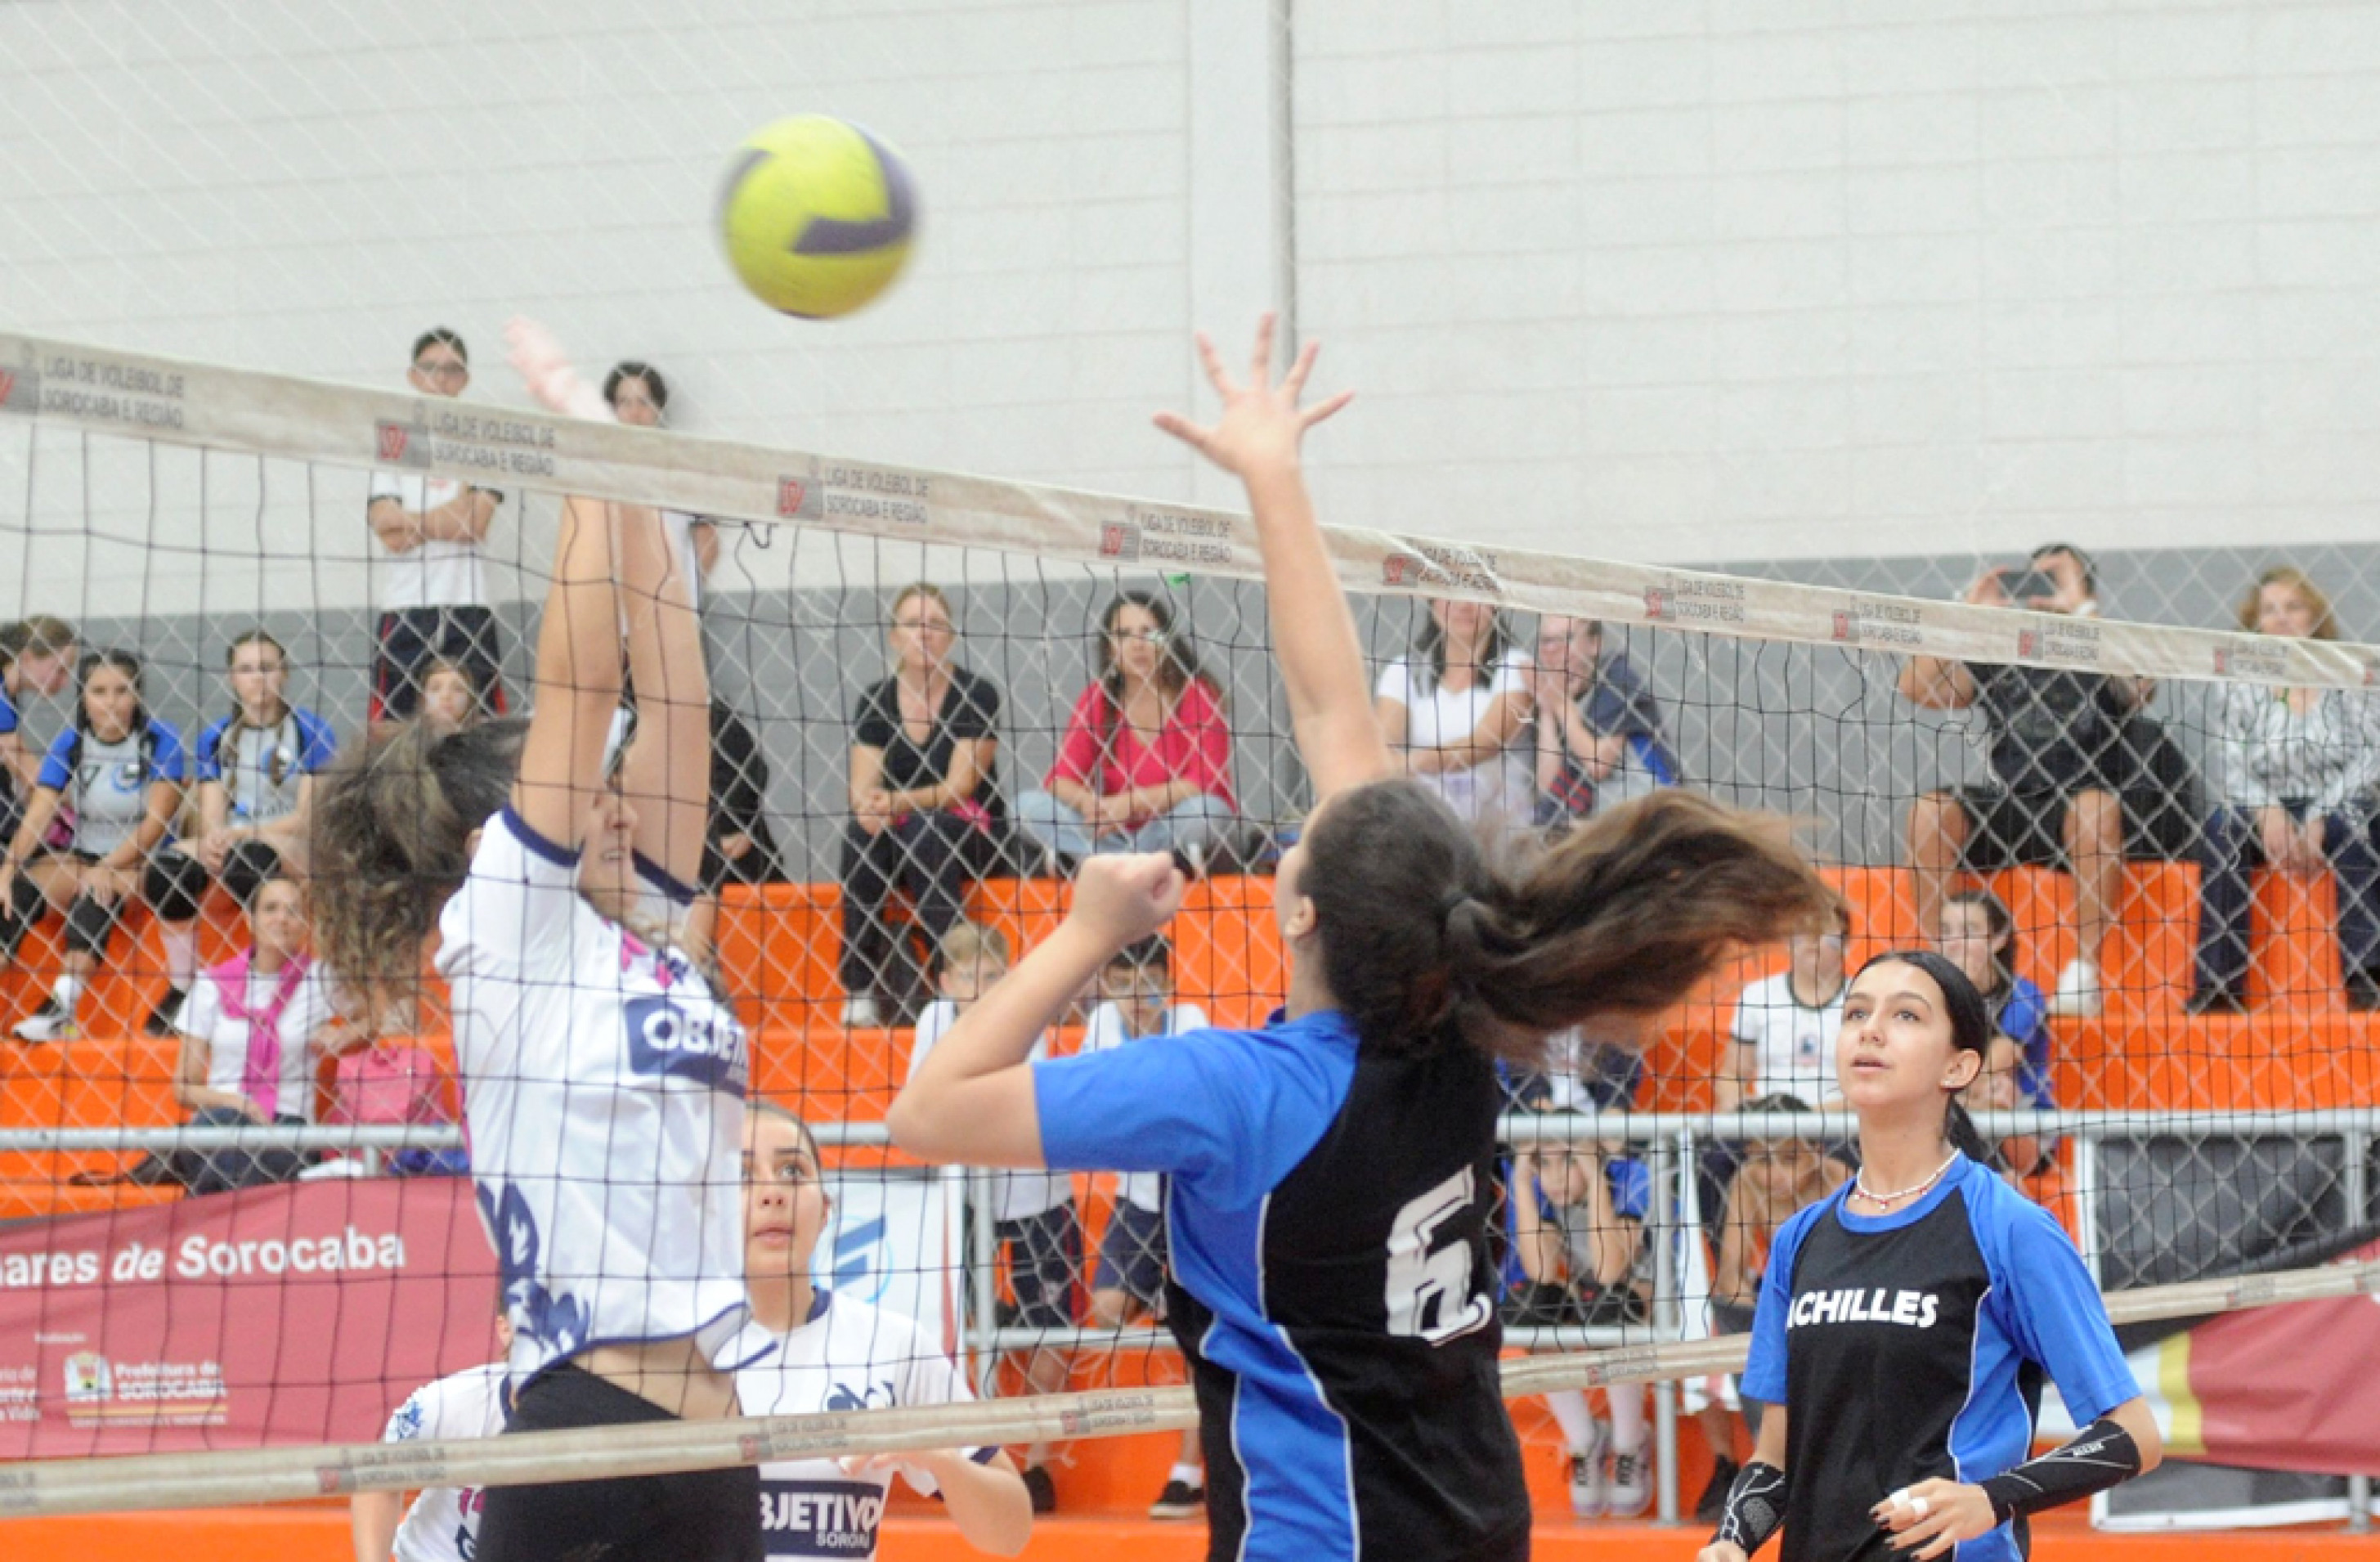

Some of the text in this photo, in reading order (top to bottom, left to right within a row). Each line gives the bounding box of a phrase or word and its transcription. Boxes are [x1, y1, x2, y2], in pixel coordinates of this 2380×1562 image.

[43, 355, 184, 398] LIGA DE VOLEIBOL DE
[43, 388, 119, 418] SOROCABA
[122, 397, 132, 421] E
[432, 411, 554, 449] LIGA DE VOLEIBOL DE
[433, 442, 499, 468] SOROCABA
[500, 450, 508, 473] E
[824, 466, 929, 498] LIGA DE VOLEIBOL DE
[826, 494, 880, 518] SOROCABA
[882, 500, 889, 521] E
[111, 1241, 164, 1282] de
[175, 1225, 407, 1278] Sorocaba
